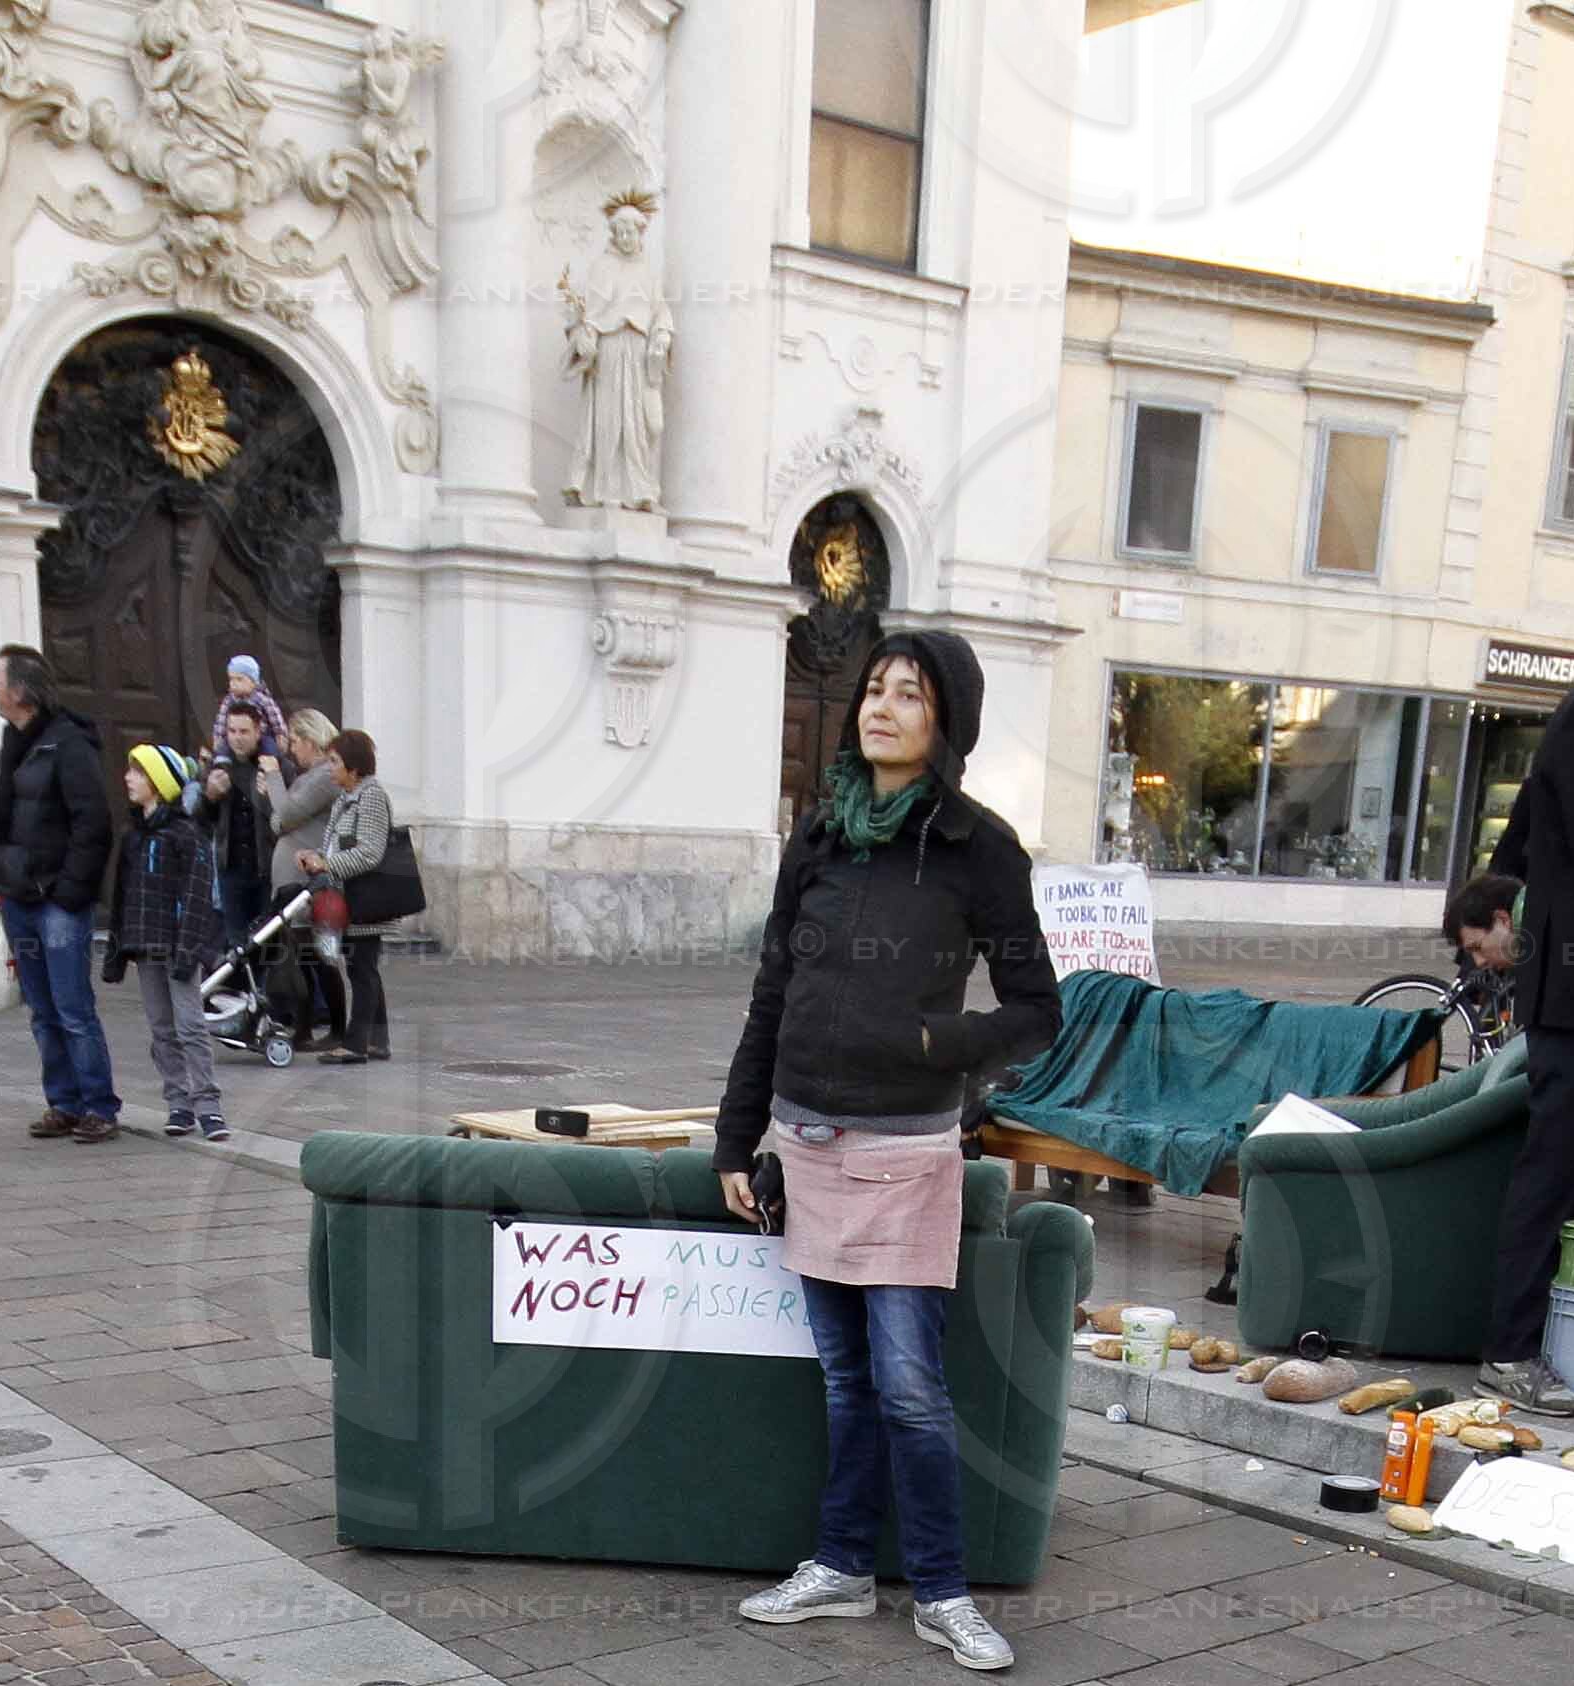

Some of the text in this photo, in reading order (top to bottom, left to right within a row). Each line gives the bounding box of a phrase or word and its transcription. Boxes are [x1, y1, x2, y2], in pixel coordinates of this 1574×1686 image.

[1044, 881, 1124, 903] IF BANKS ARE
[1102, 905, 1117, 922] TO
[1122, 905, 1148, 924] FAIL
[1071, 930, 1096, 948] ARE
[1057, 953, 1153, 977] TO SUCCEED
[513, 1231, 788, 1271] WAS MUS
[509, 1275, 812, 1327] NOCH PASSIER
